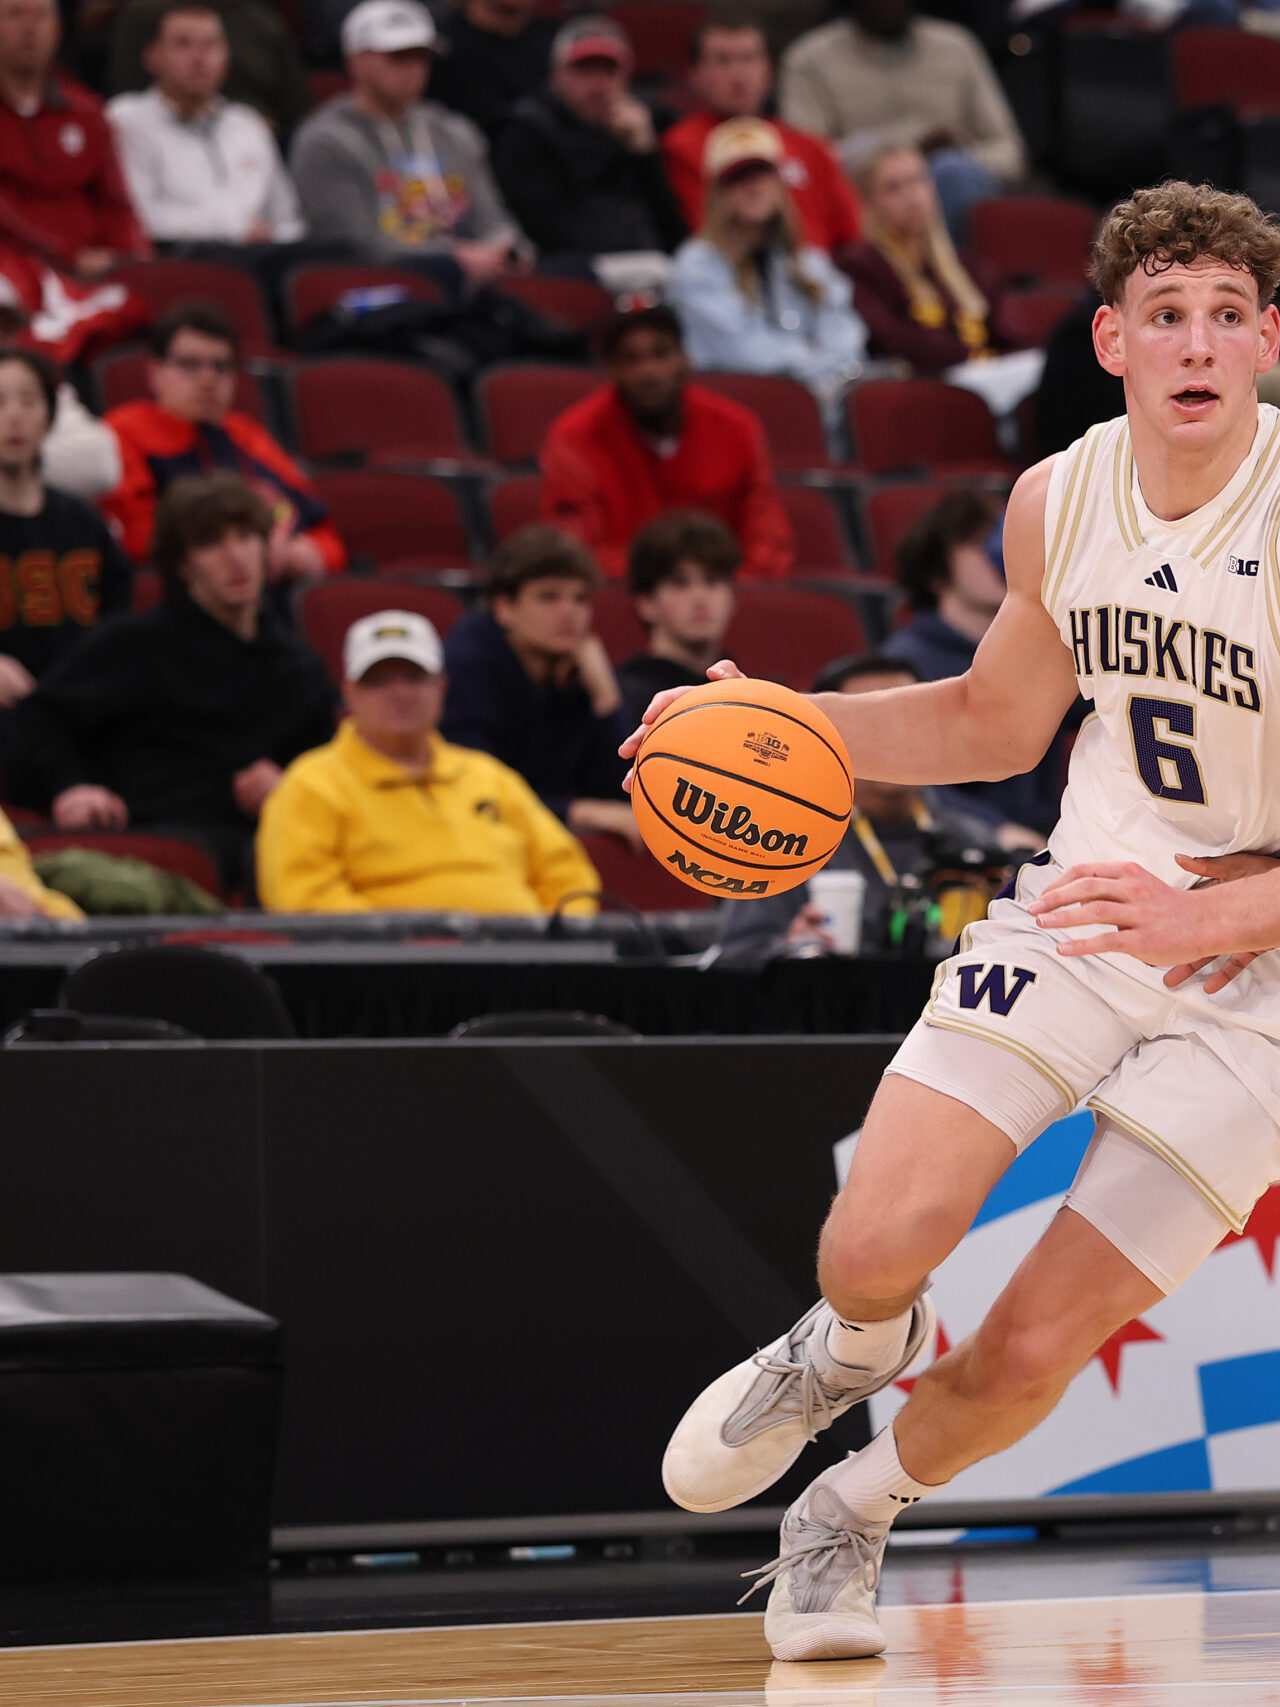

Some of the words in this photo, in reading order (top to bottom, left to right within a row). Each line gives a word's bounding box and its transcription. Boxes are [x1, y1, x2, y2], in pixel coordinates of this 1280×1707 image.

[1069, 603, 1263, 715] HUSKIES
[1126, 693, 1209, 807] 6
[672, 776, 808, 856] Wilson
[666, 850, 769, 894] NCAA
[956, 961, 1038, 1018] W
